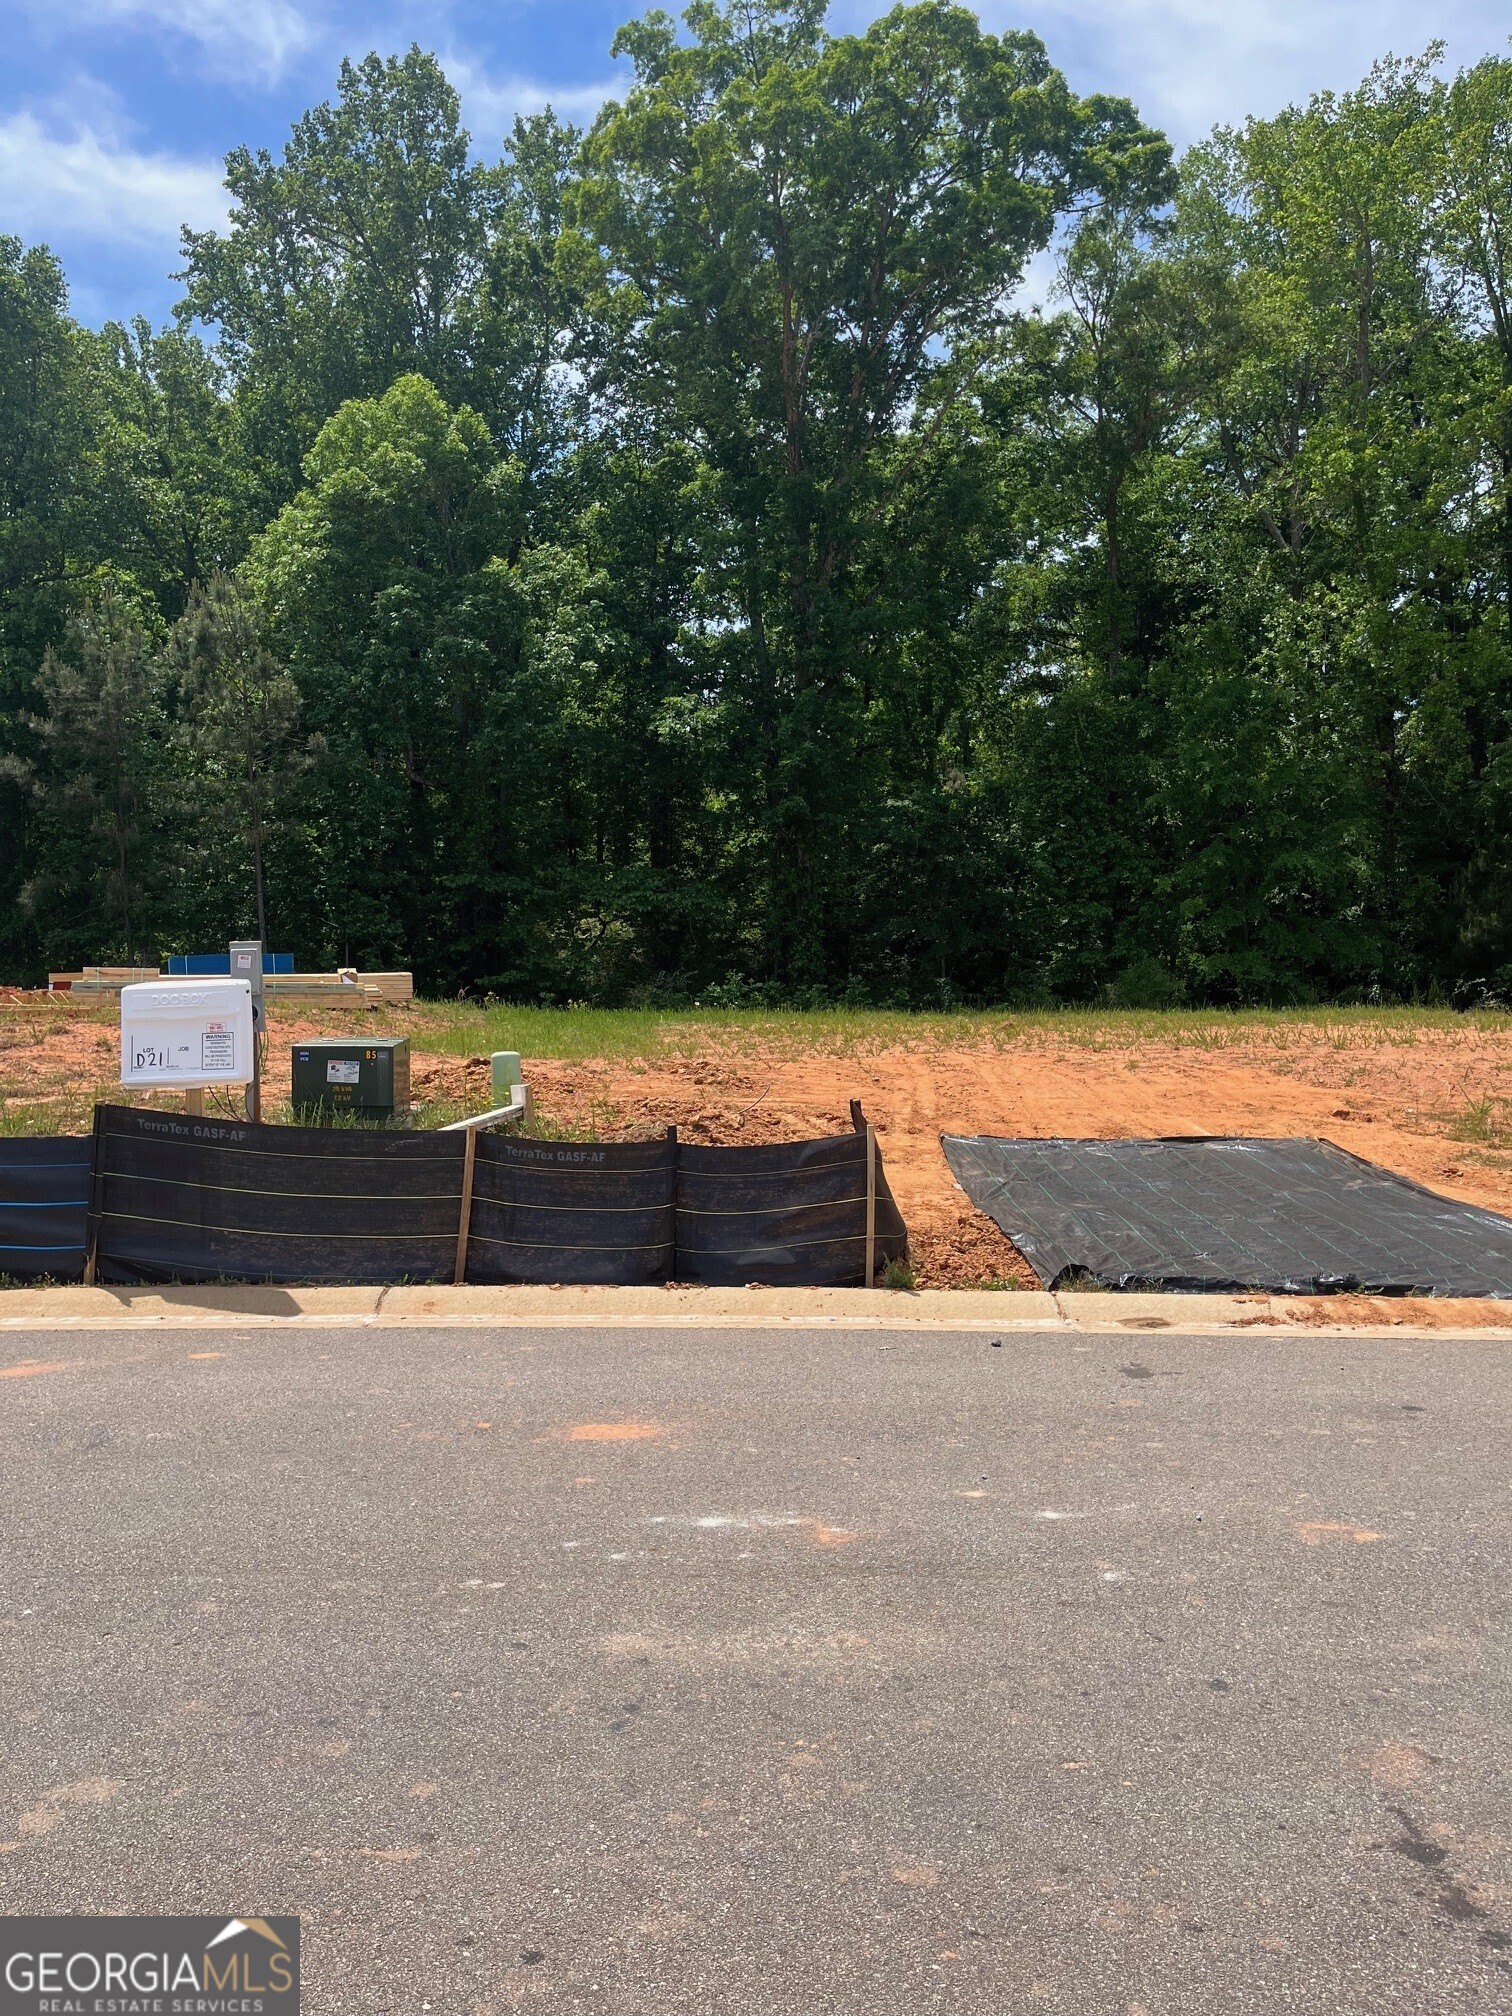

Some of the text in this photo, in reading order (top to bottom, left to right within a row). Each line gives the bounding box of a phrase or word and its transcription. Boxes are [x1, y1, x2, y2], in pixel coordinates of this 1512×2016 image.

[136, 1052, 163, 1067] D21
[137, 1118, 247, 1142] TerraTex GASF-AF
[505, 1145, 606, 1163] TerraTex GASF-AF
